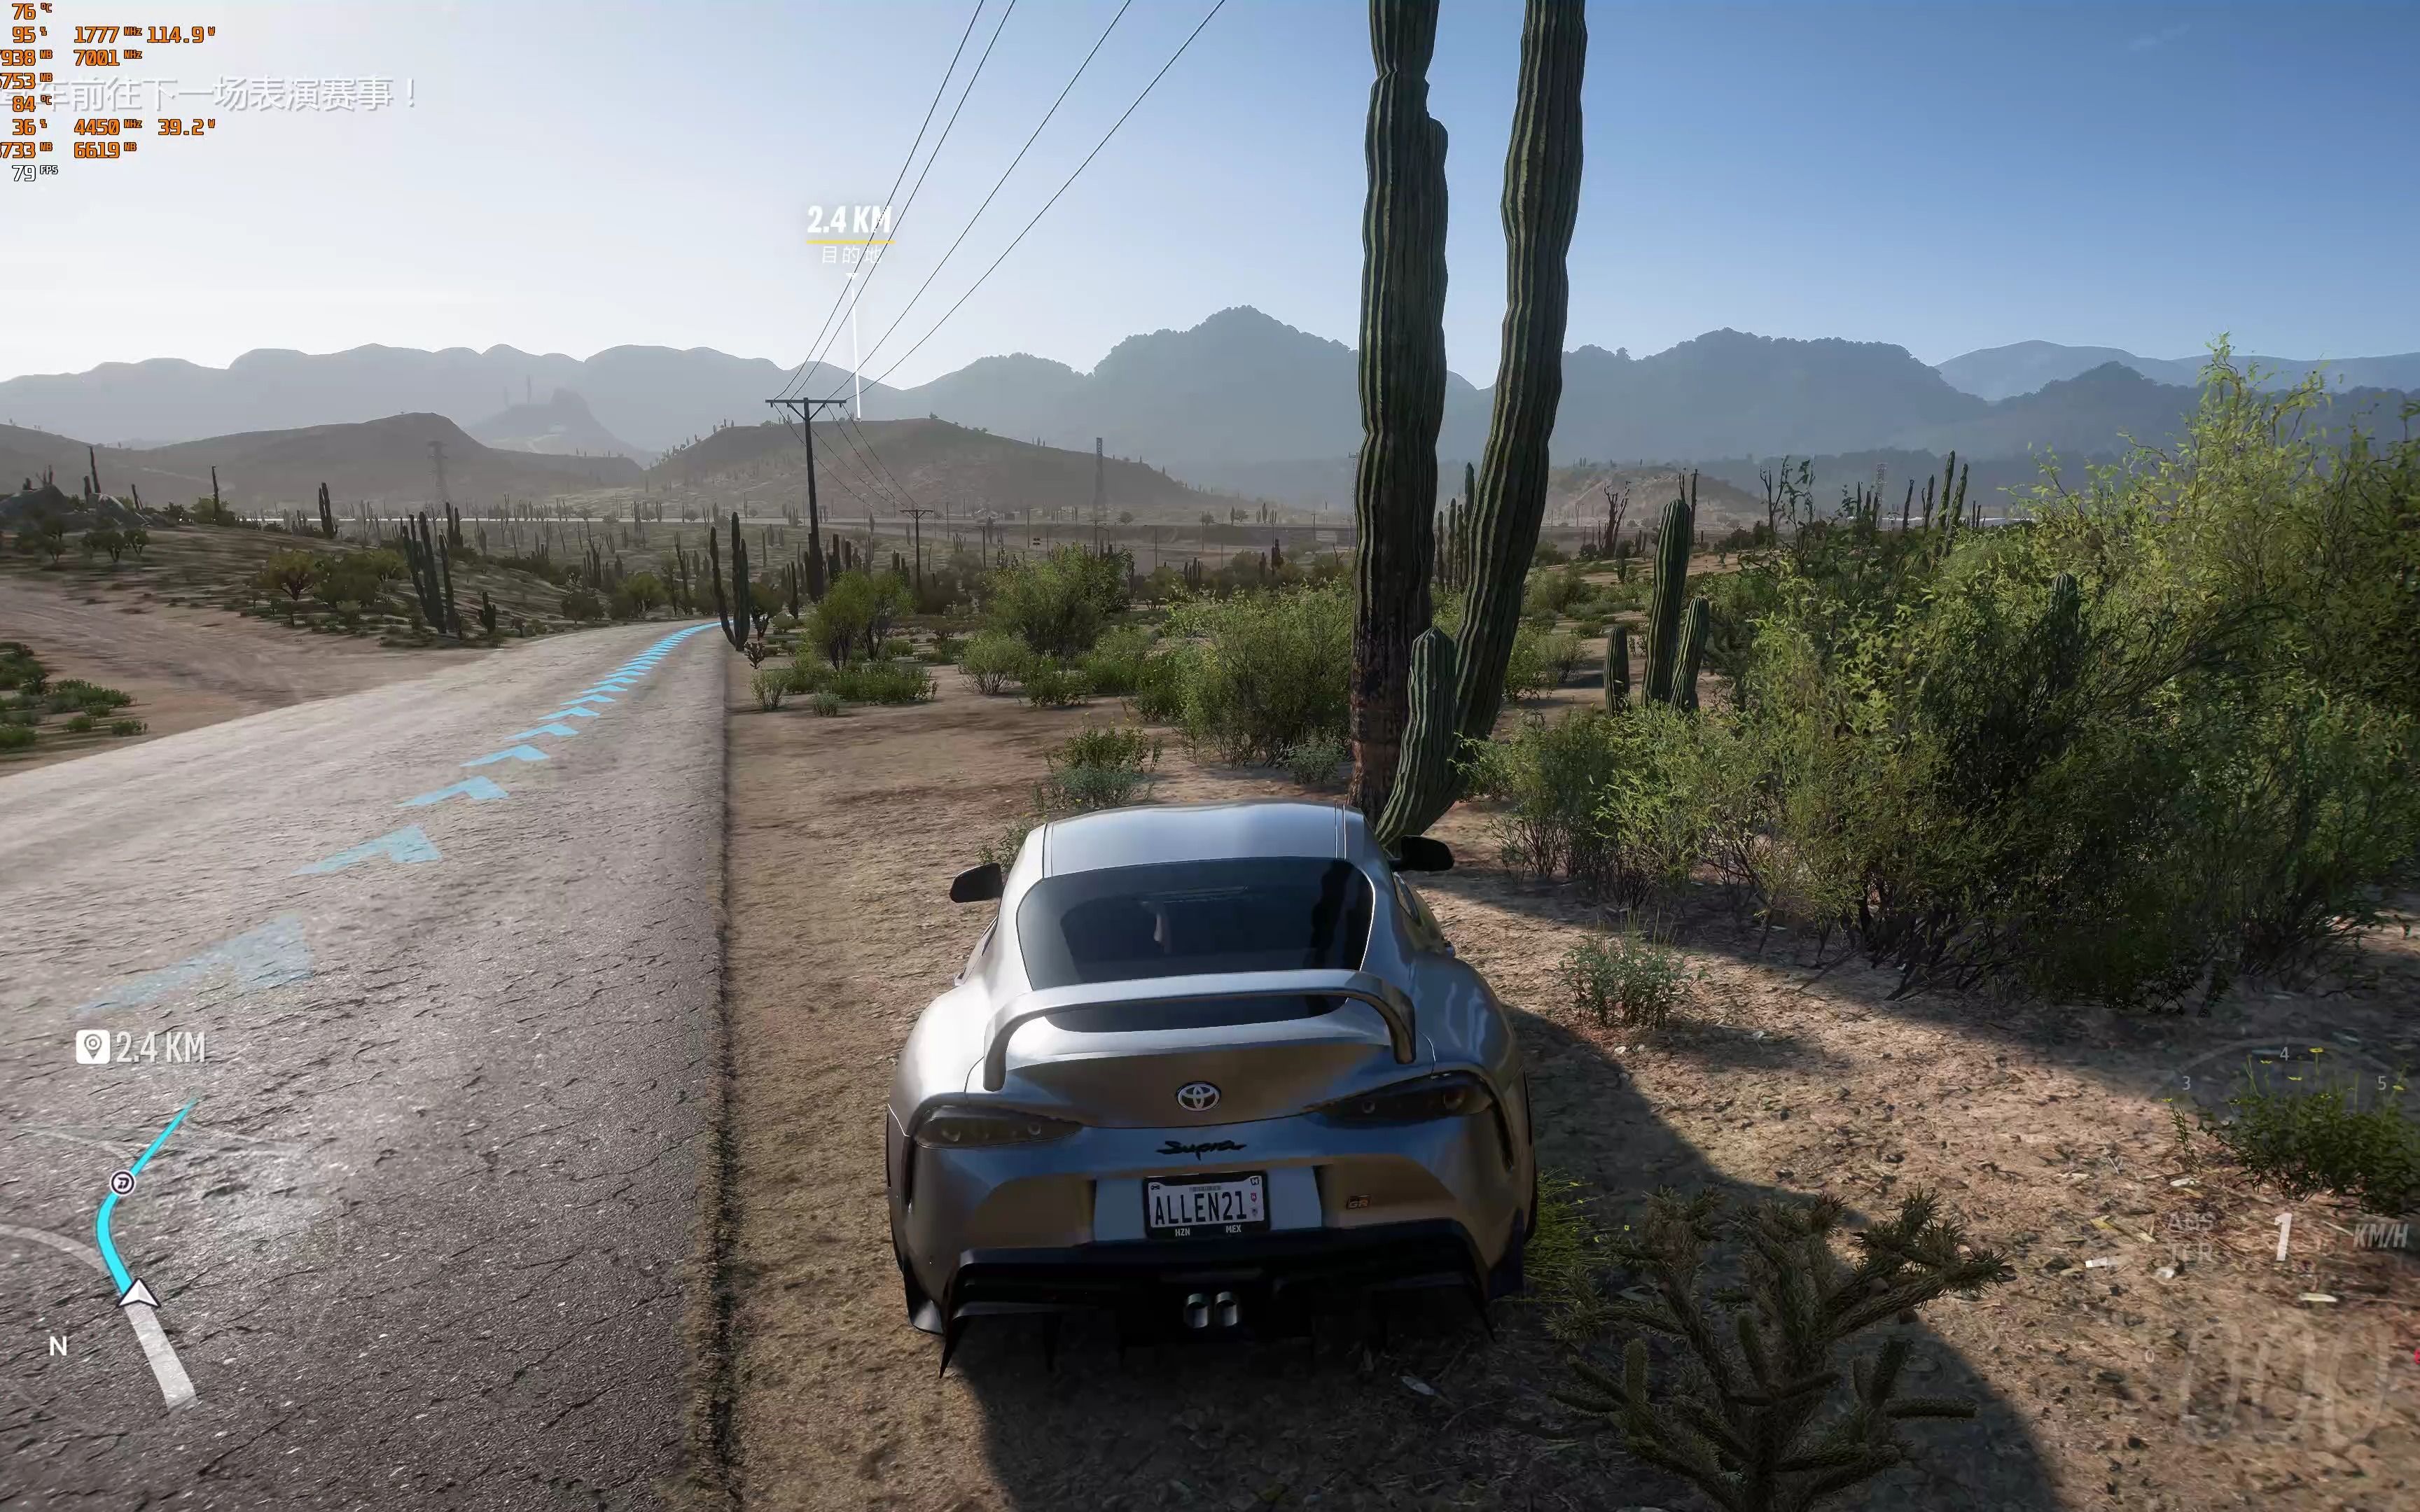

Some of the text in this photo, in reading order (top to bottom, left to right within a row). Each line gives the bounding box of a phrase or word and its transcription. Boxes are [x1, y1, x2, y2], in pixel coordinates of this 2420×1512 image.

[1155, 1140, 1246, 1161] Supra
[1155, 1191, 1246, 1225] ALLEN21
[1175, 1228, 1190, 1236] HZN
[1226, 1224, 1242, 1233] MEX
